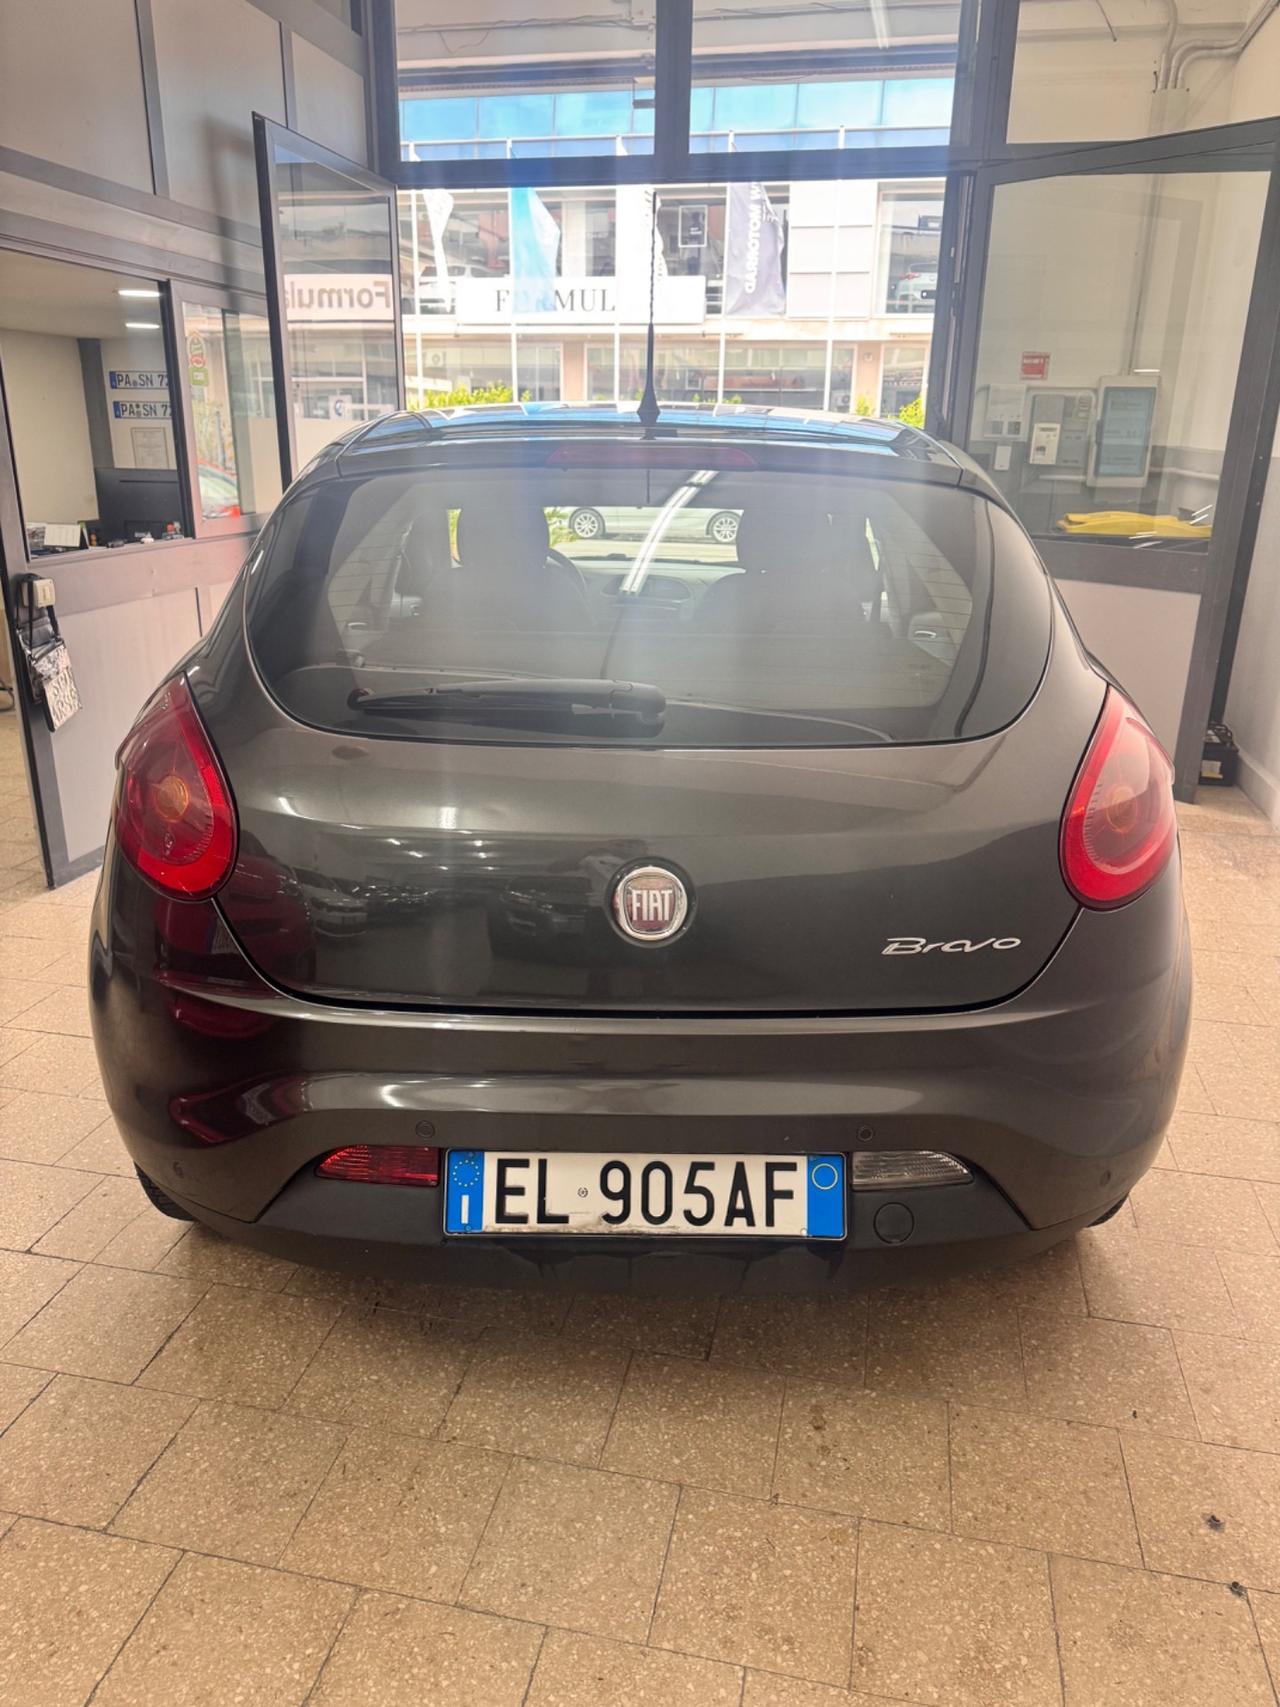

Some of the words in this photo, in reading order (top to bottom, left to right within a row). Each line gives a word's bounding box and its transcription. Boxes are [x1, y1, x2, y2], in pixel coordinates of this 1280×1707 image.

[117, 373, 131, 386] PA
[138, 373, 154, 387] SN
[120, 403, 135, 416] PA
[142, 403, 157, 416] SN
[631, 889, 673, 921] FIAT
[881, 937, 1022, 955] Bravo
[495, 1158, 570, 1224] EL
[599, 1159, 797, 1227] 905AF
